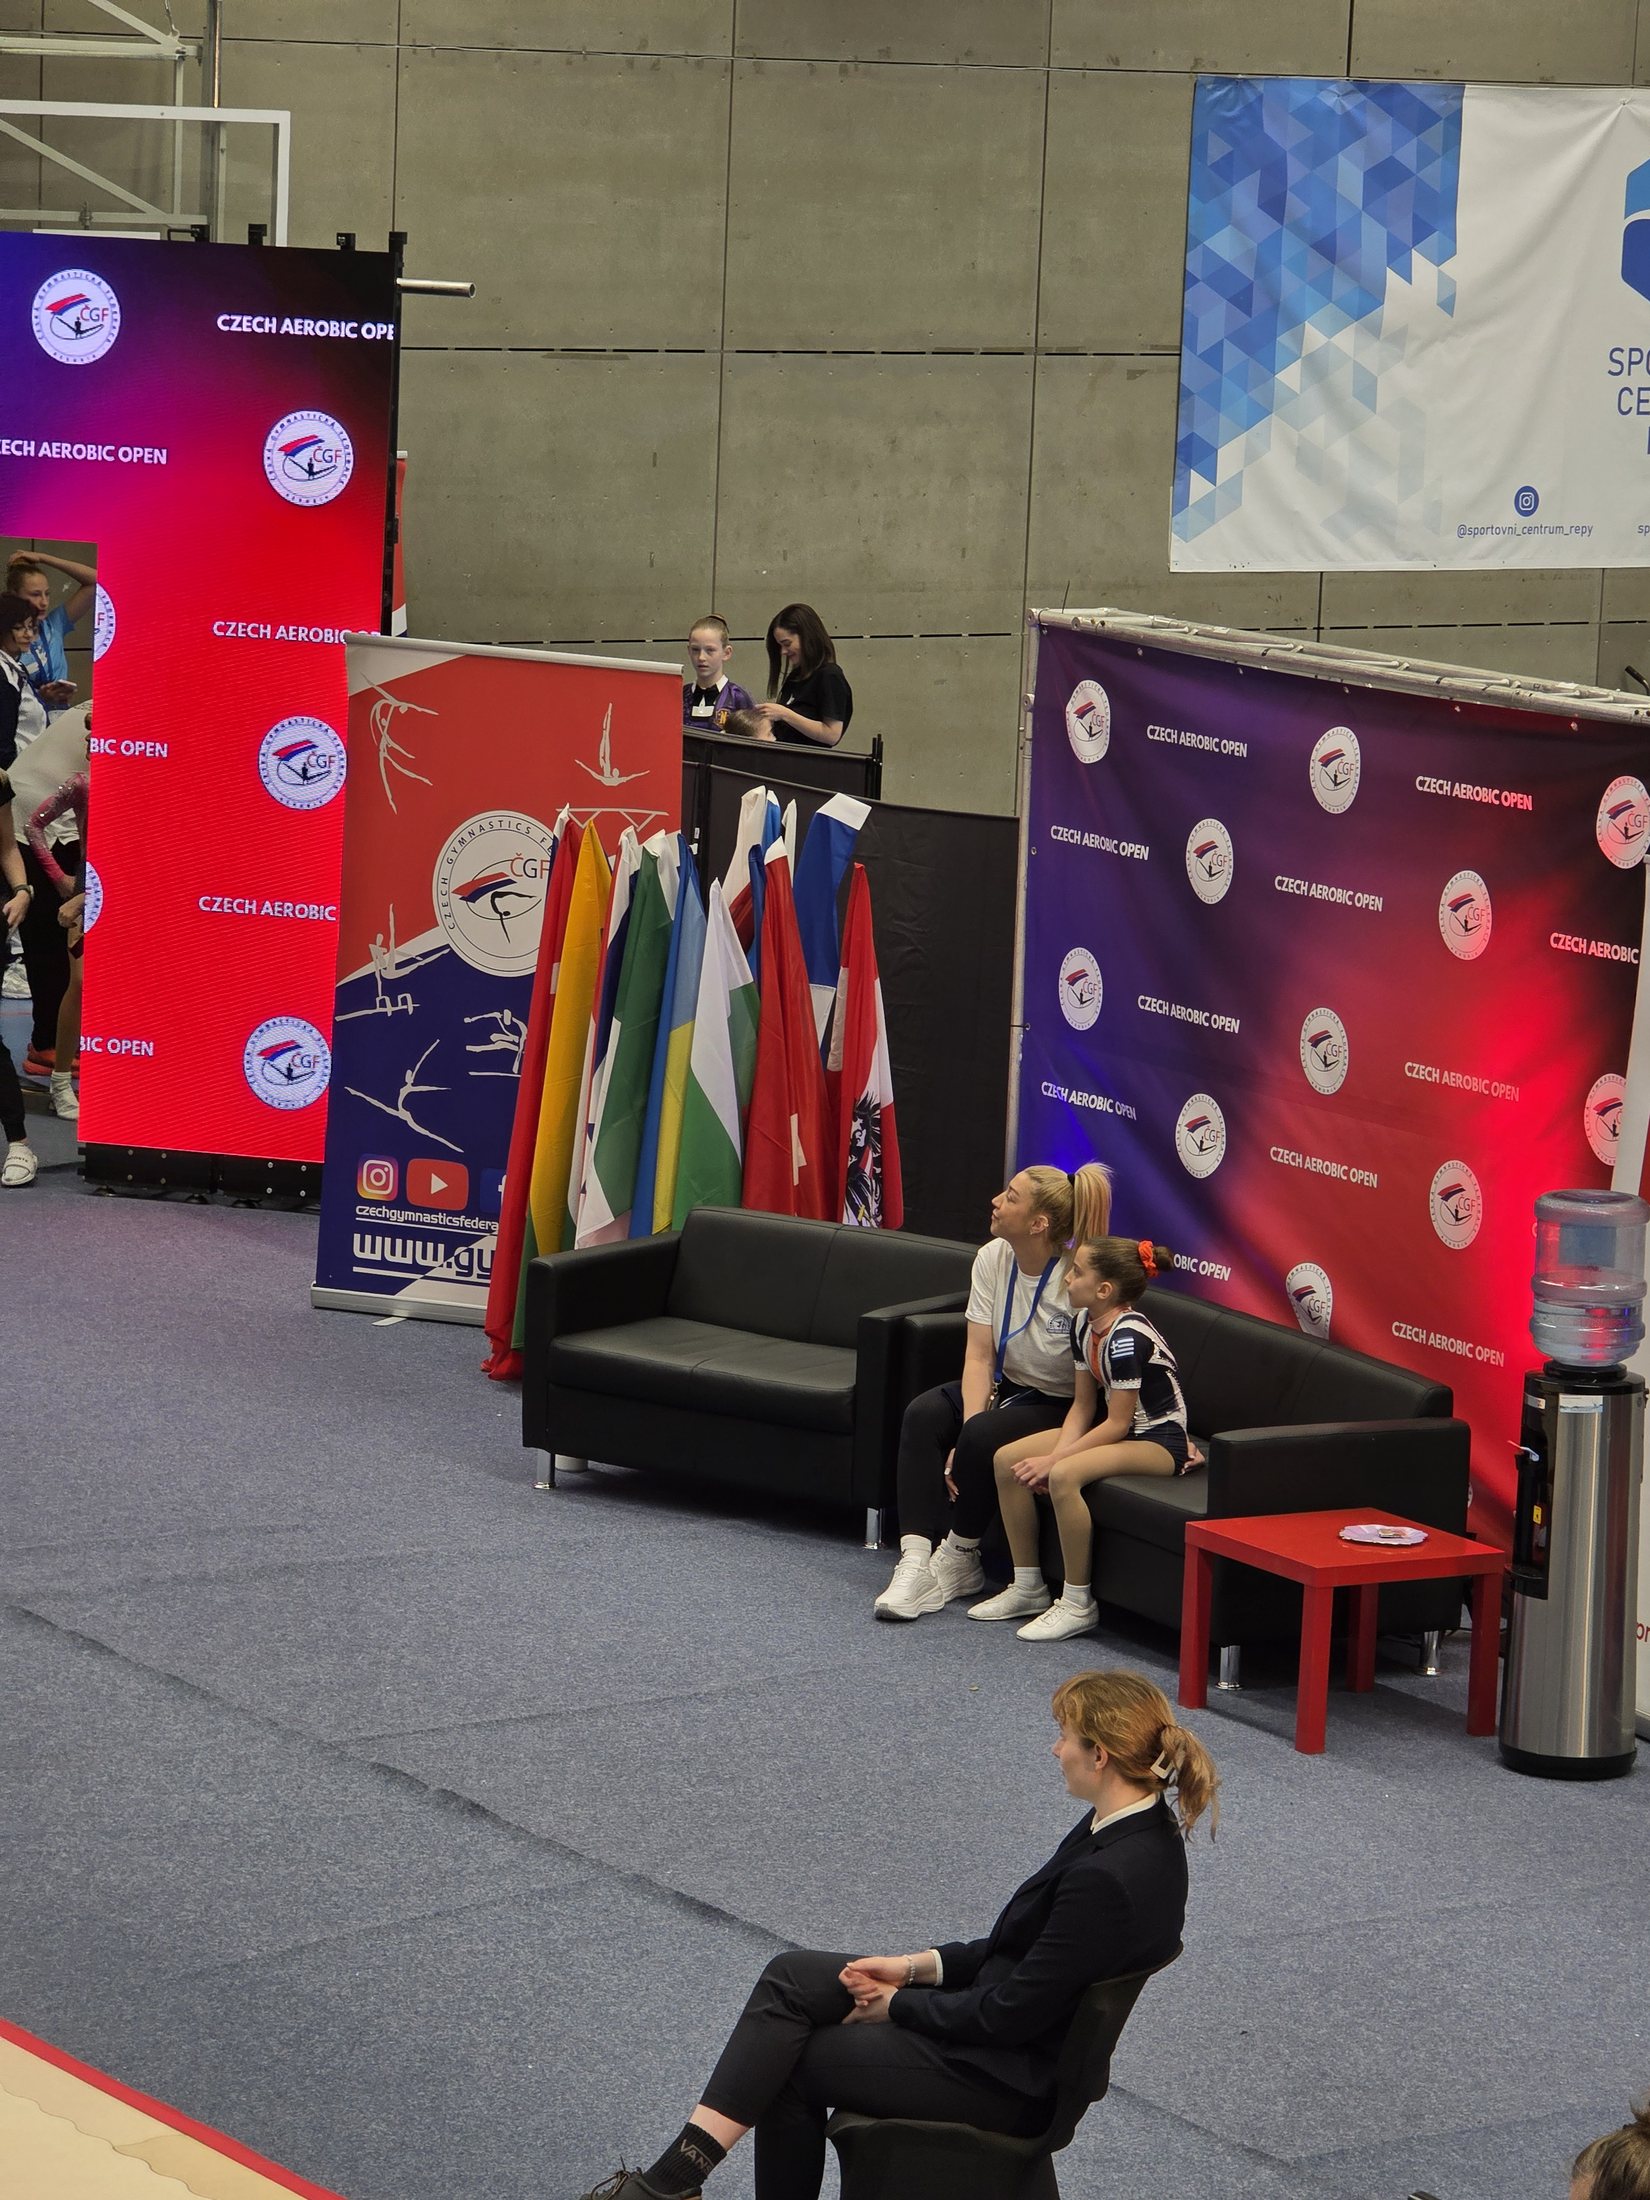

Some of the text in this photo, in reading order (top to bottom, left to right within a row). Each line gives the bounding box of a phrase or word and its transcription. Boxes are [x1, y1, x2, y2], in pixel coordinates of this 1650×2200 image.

[80, 305, 109, 322] ČGF
[216, 313, 277, 334] CZECH
[279, 317, 359, 339] AEROBIC
[1607, 347, 1650, 377] SP
[38, 441, 116, 462] AEROBIC
[118, 446, 168, 465] OPEN
[313, 446, 342, 463] ČGF
[1457, 523, 1594, 538] @sportovni_centrum_repy
[213, 620, 271, 639] CZECH
[120, 740, 168, 758] OPEN
[1147, 724, 1248, 758] CZECH AEROBIC OPEN
[1337, 759, 1355, 776] ČGF
[1416, 776, 1533, 811] CZECH AEROBIC OPEN
[1627, 810, 1649, 828] ČGF
[446, 820, 532, 865] GYMNASTICS
[1051, 825, 1149, 861] CZECH AEROBIC OPEN
[510, 853, 550, 879] ČGF
[1211, 852, 1228, 869] ČGF
[441, 877, 456, 930] CZECH
[1275, 875, 1383, 912] CZECH AEROBIC OPEN
[198, 896, 337, 921] CZECH AEROBIC
[1468, 904, 1486, 921] ČGF
[1550, 933, 1639, 964] CZECH AEROBIC
[1138, 995, 1240, 1034] CZECH AEROBIC OPEN
[107, 1038, 154, 1056] OPEN
[1326, 1039, 1342, 1058] ČGF
[1405, 1062, 1520, 1102] CZECH AEROBIC OPEN
[1041, 1081, 1137, 1121] CZECH AEROBIC OPEN
[1203, 1126, 1221, 1144] ČGF
[1270, 1147, 1378, 1189] CZECH AEROBIC OPEN
[1457, 1195, 1476, 1213] ČGF
[355, 1205, 499, 1231] czechgymnasticsfedera
[1199, 1261, 1232, 1282] OPEN
[1308, 1295, 1326, 1316] ČGF
[1391, 1321, 1505, 1367] CZECH AEROBIC OPEN
[680, 2139, 715, 2174] VANS
